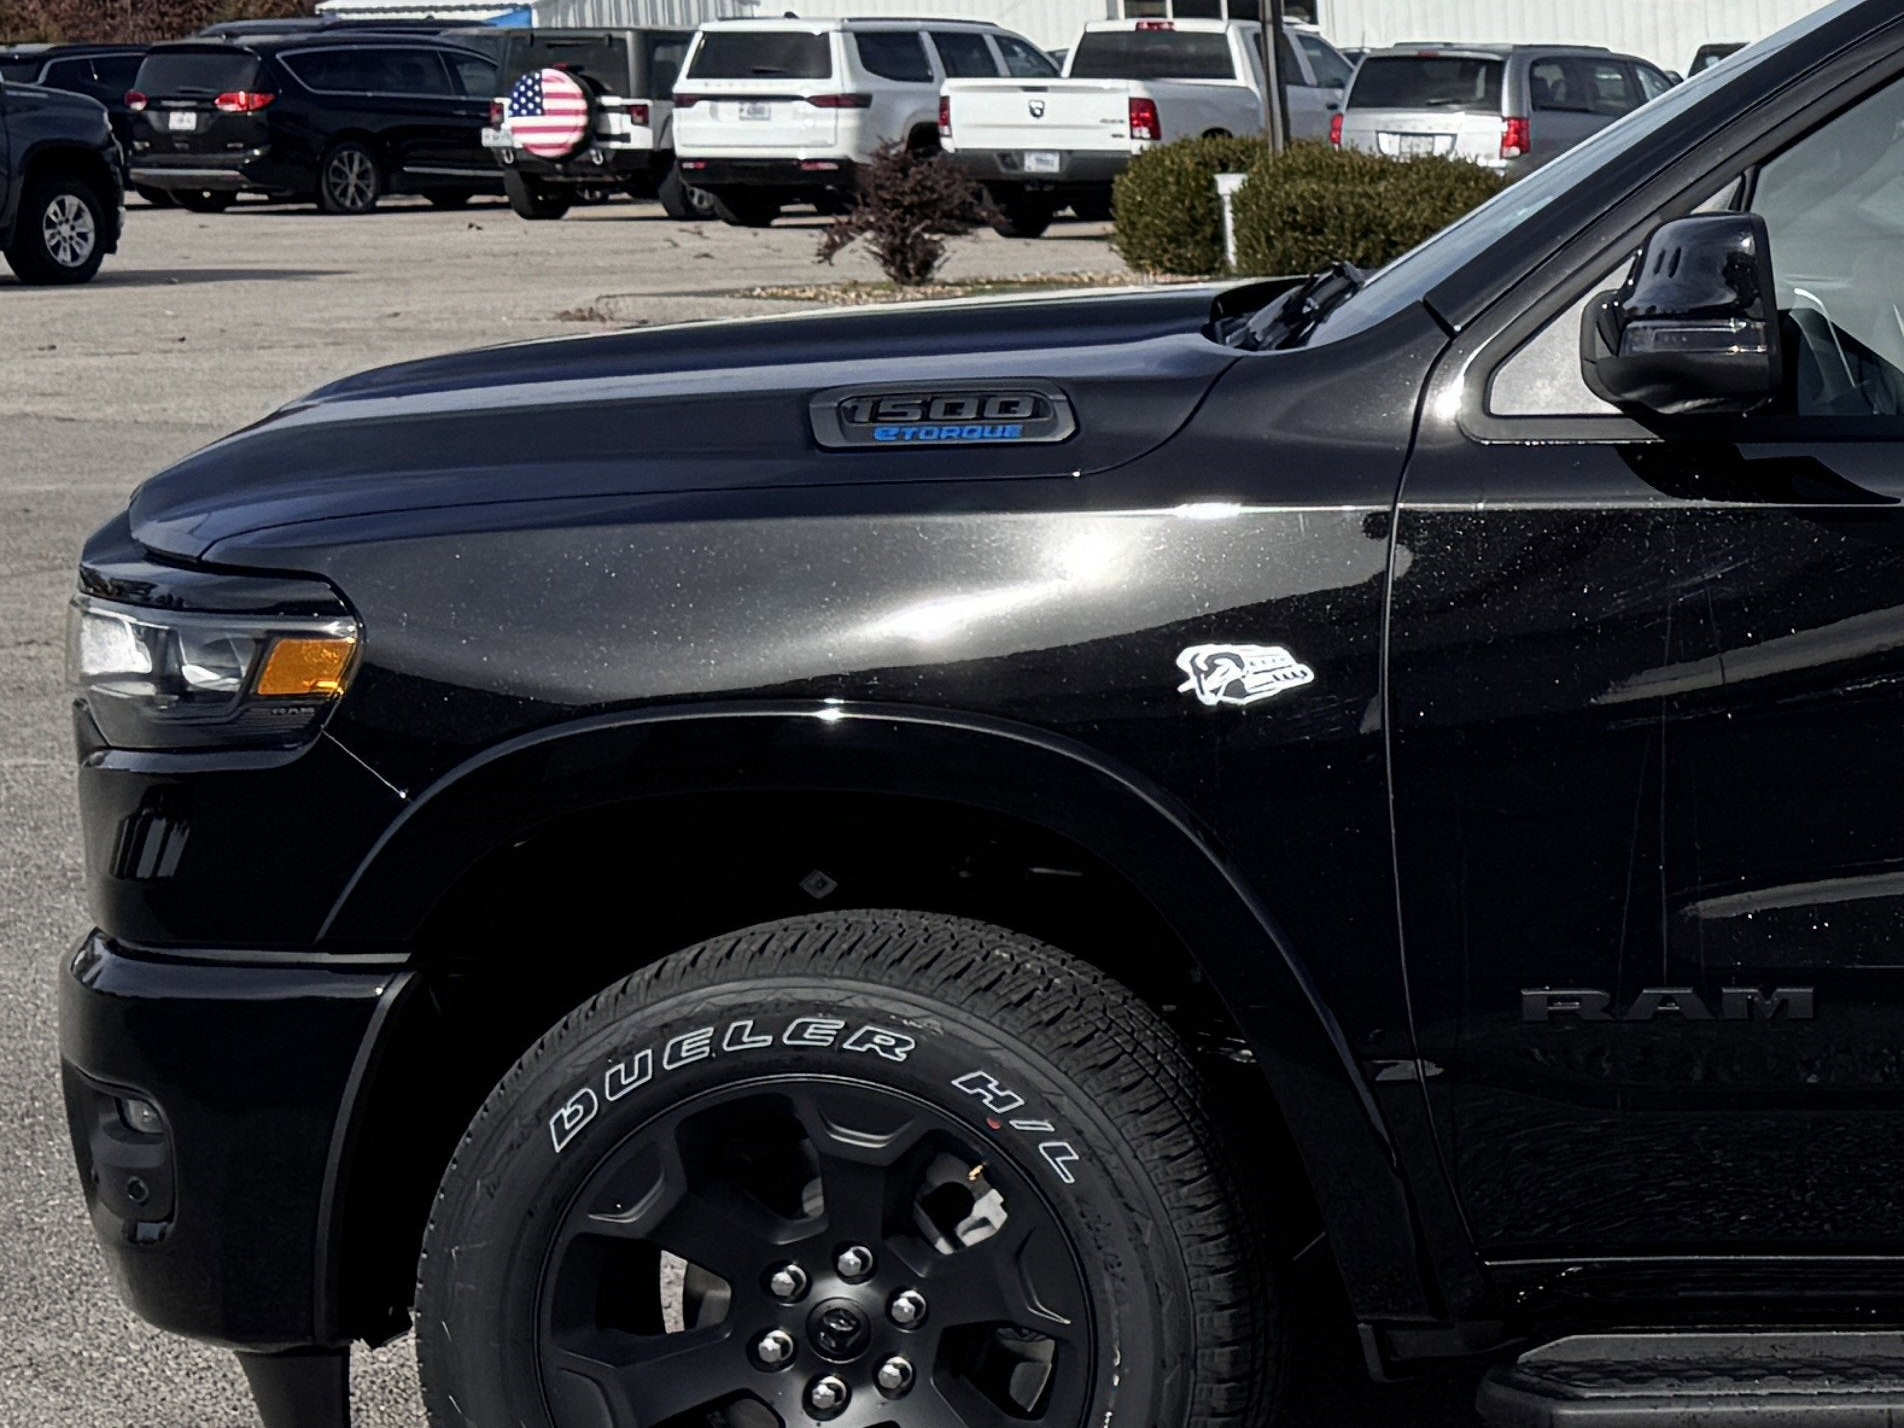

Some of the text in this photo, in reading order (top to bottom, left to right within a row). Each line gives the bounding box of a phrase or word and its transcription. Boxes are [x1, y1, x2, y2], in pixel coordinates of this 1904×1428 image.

[852, 394, 1036, 423] 1500
[1519, 984, 1817, 1023] RAM
[548, 1017, 1082, 1185] DUELER H/L
